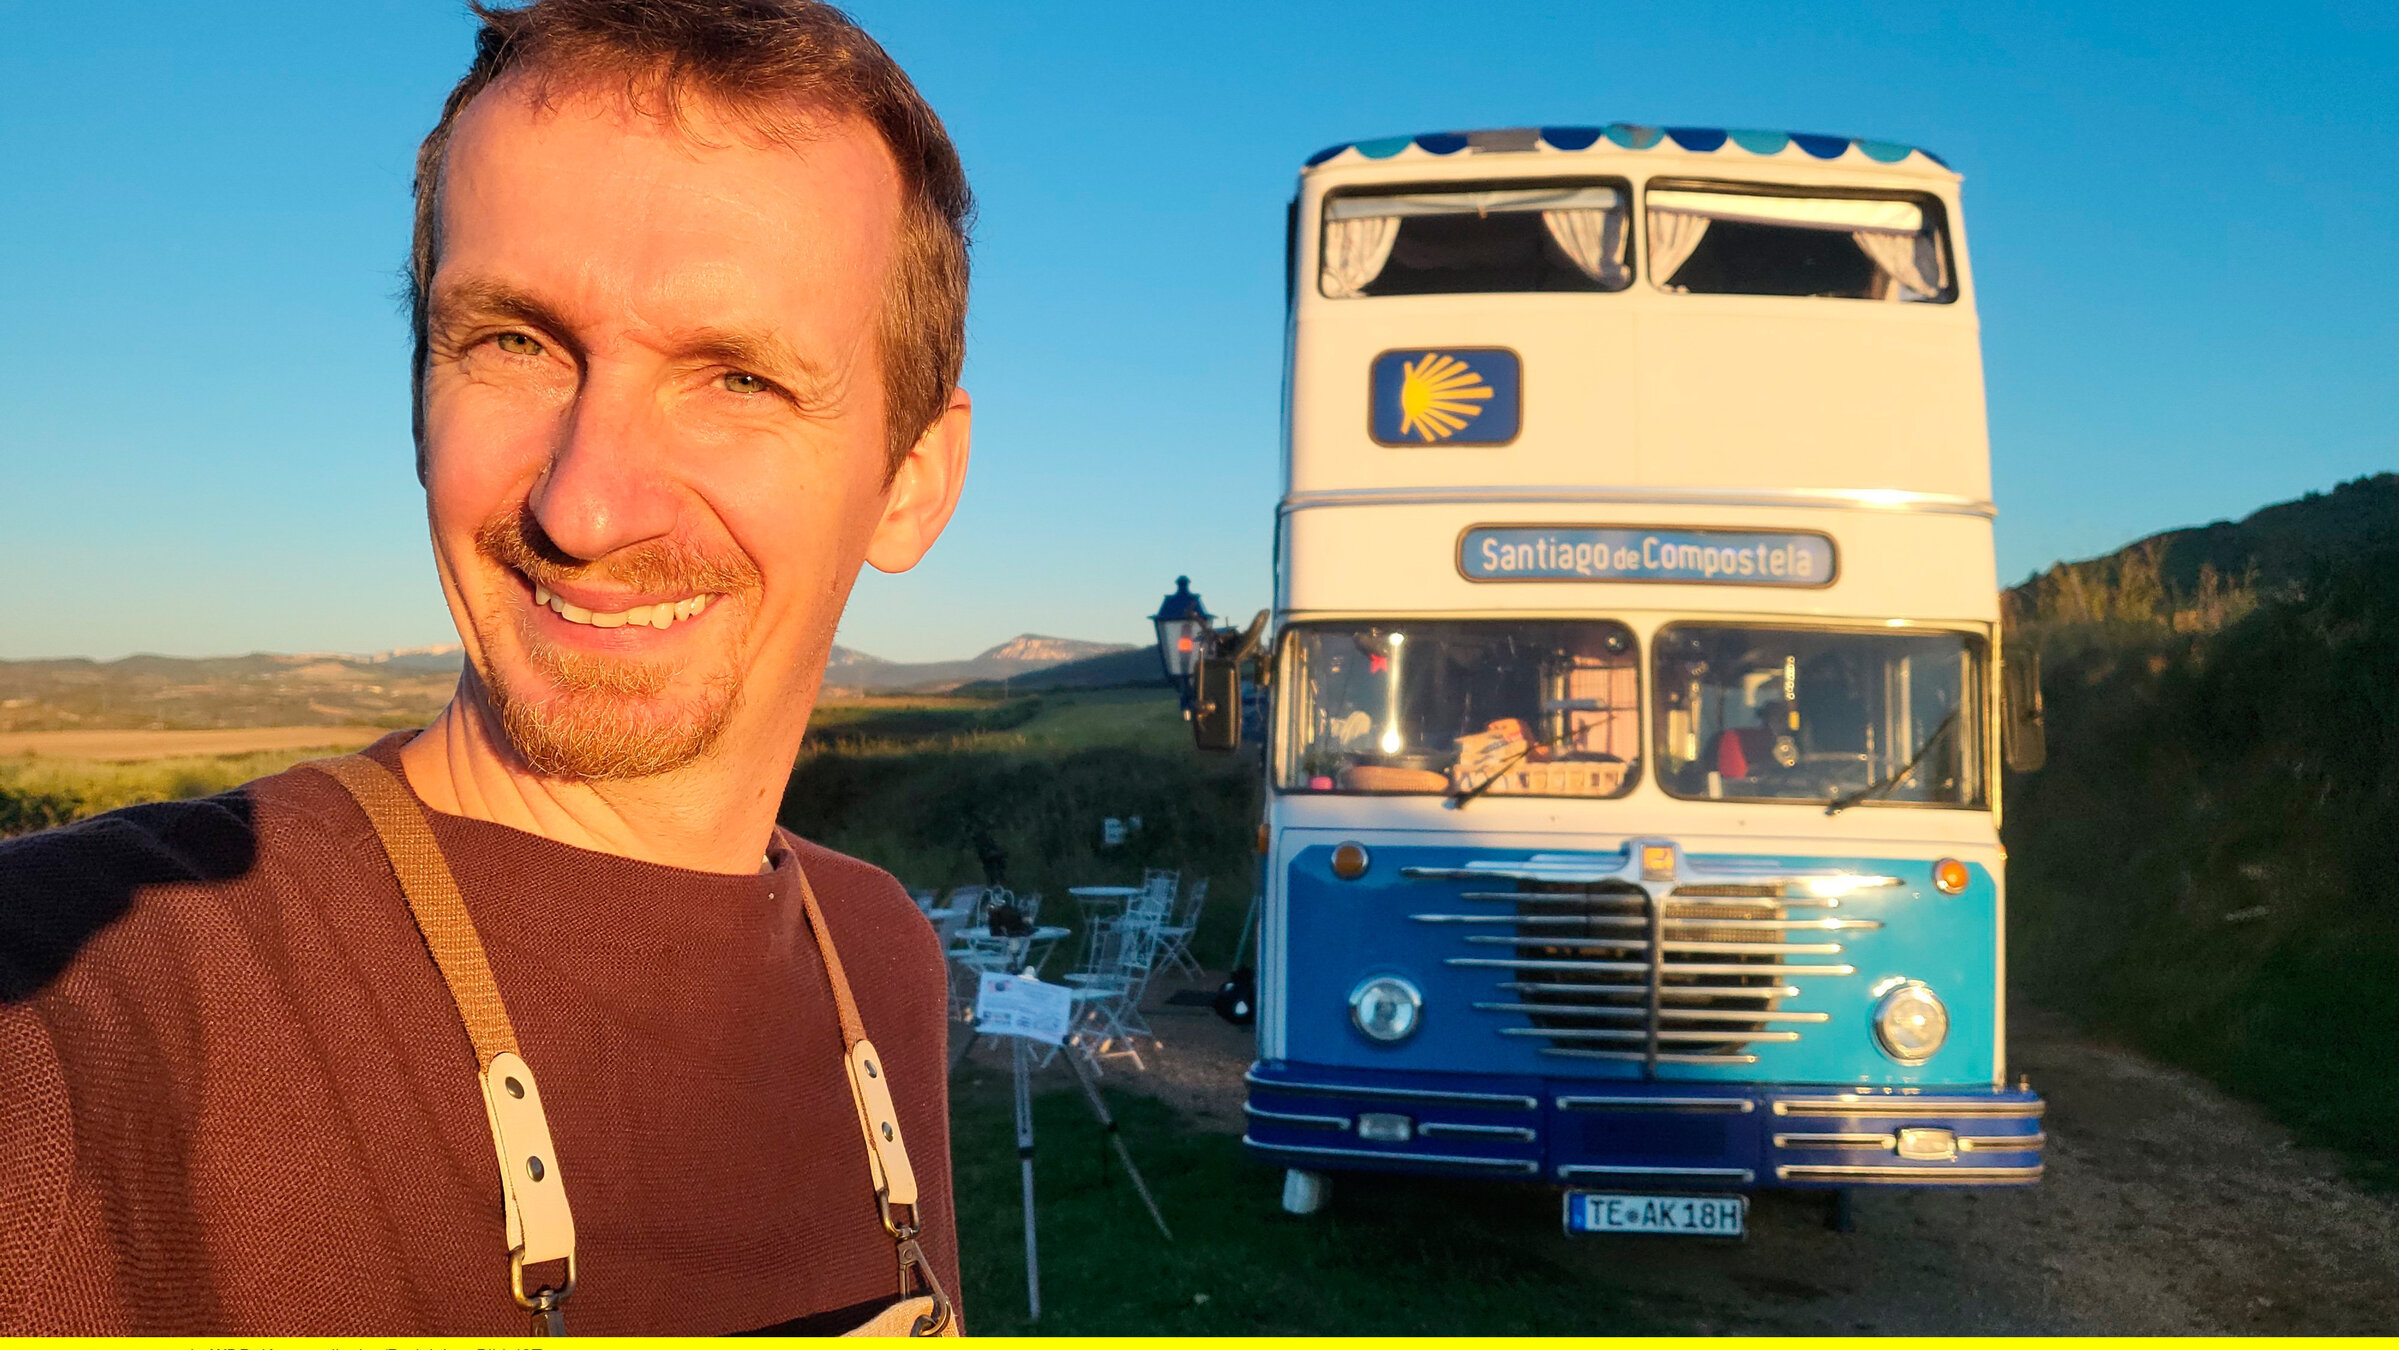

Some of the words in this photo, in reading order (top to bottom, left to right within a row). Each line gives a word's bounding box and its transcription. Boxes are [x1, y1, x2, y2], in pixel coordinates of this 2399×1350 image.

[1482, 537, 1609, 576] Santiago
[1613, 546, 1640, 570] de
[1642, 536, 1813, 578] Compostela
